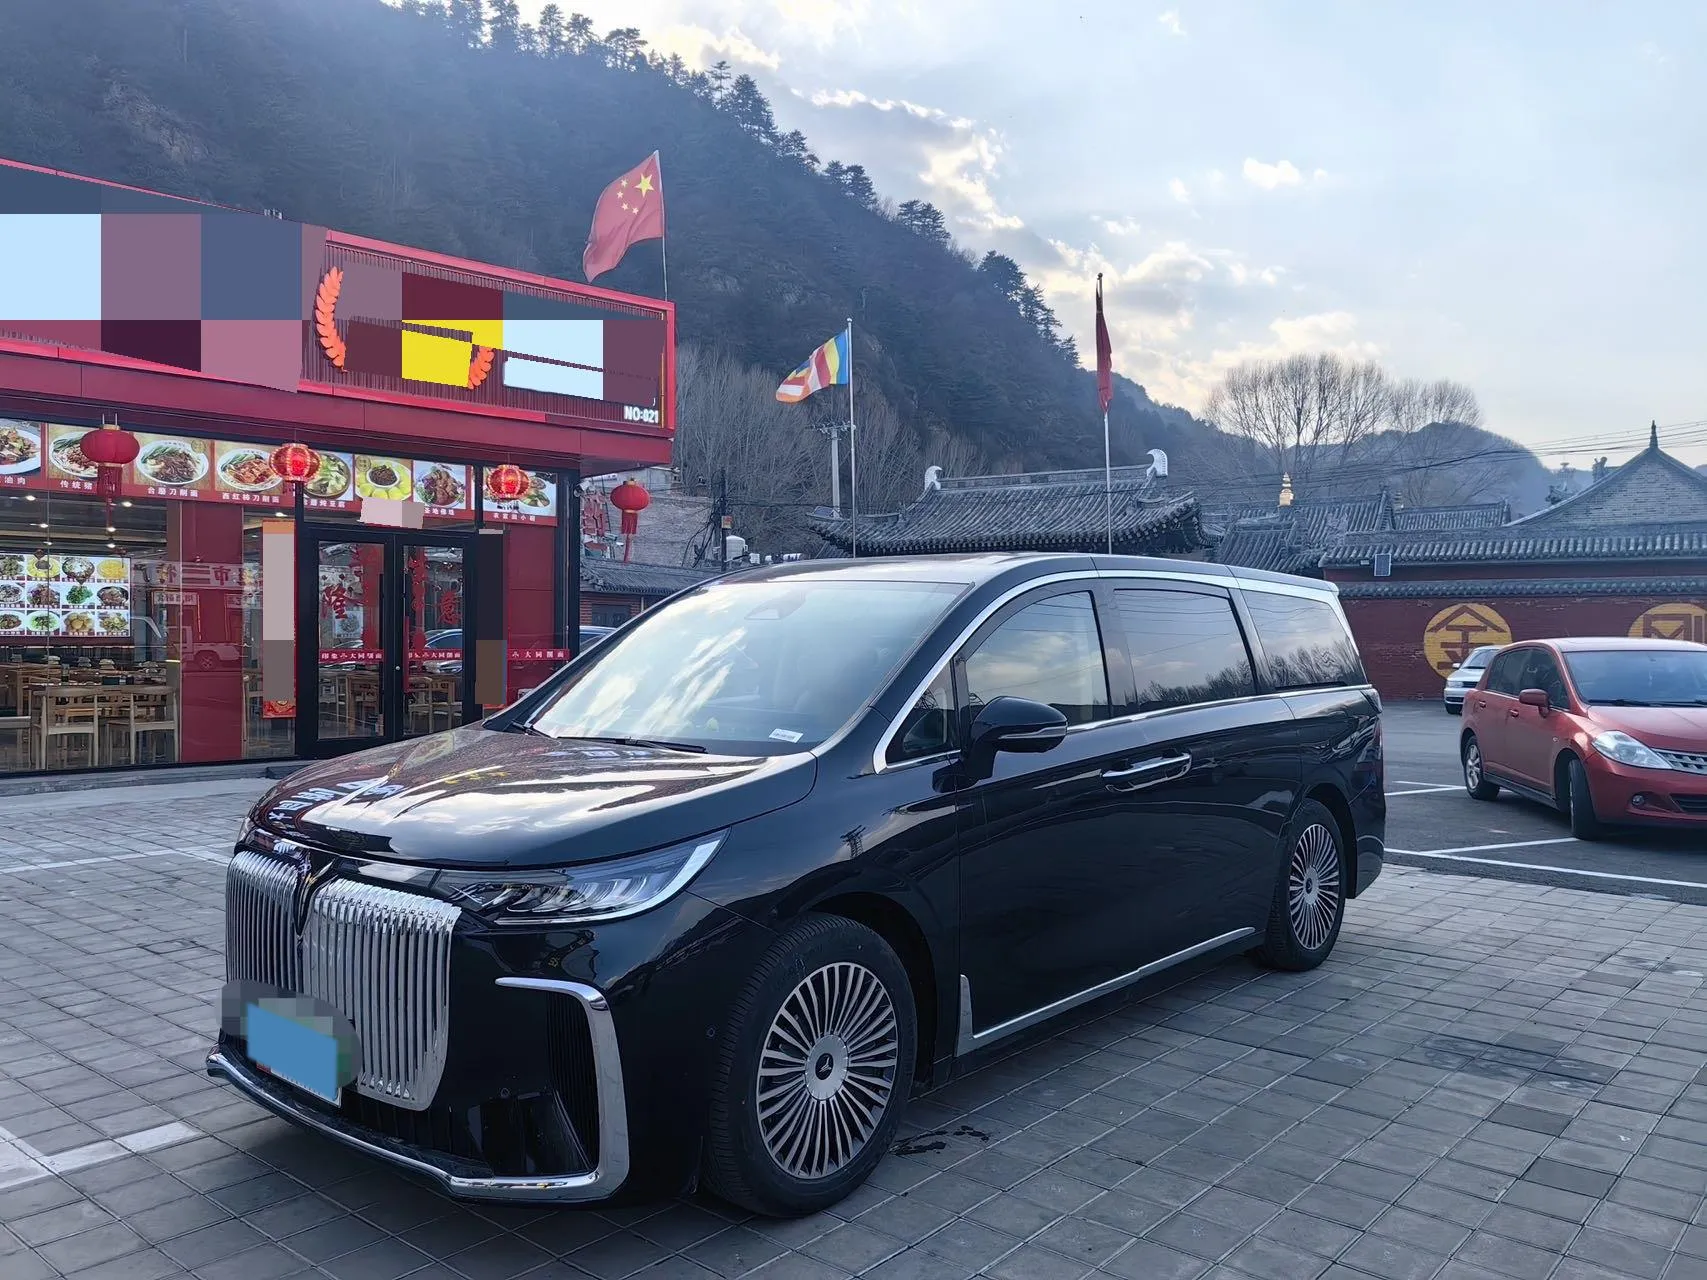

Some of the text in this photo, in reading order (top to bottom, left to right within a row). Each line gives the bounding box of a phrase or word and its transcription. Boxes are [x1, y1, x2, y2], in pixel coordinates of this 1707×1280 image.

[0, 475, 26, 485] 油肉
[60, 480, 93, 490] 传统猪
[222, 492, 280, 503] 西红柿刀削面
